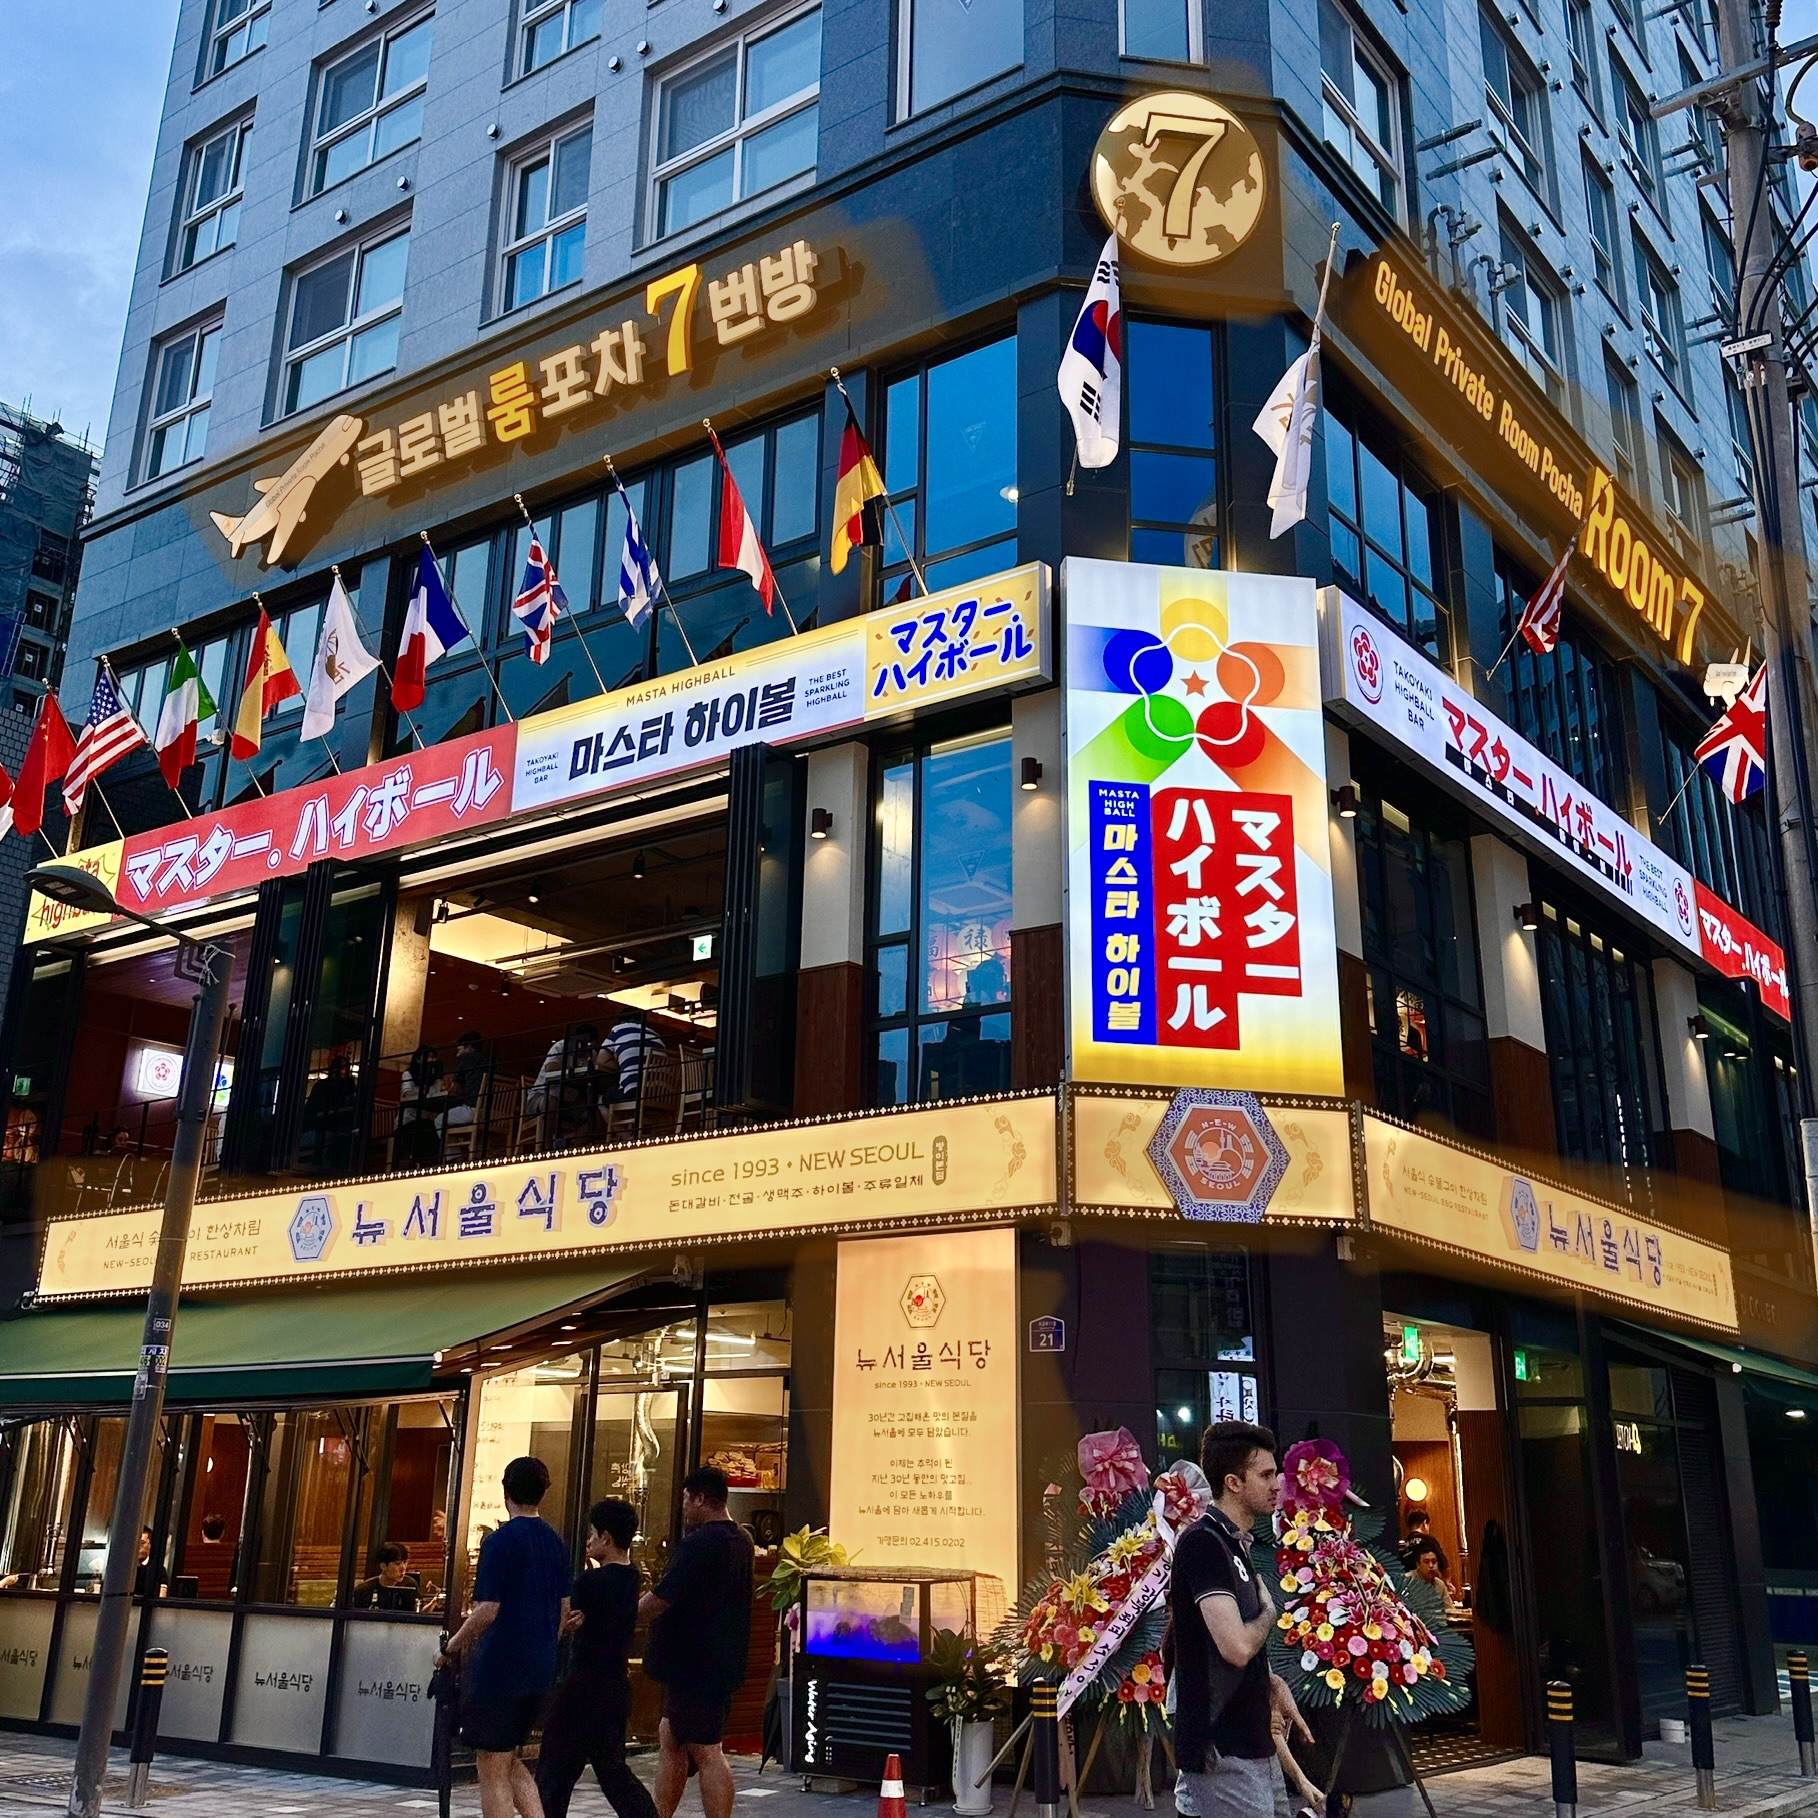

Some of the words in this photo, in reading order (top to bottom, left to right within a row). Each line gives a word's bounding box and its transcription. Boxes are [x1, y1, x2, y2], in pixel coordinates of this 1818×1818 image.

[1144, 111, 1230, 239] 7
[1374, 260, 1433, 352] Global
[1433, 326, 1495, 421] Private
[1498, 399, 1541, 474] Room
[1540, 446, 1583, 521] Pocha
[1678, 576, 1705, 667] 7
[873, 622, 1033, 697] ハイボール
[626, 686, 667, 707] MASTA
[672, 665, 736, 695] HIGHBALL
[808, 675, 824, 686] THE
[826, 668, 847, 682] BEST
[1393, 660, 1433, 701] TAKOYAKI
[804, 679, 850, 698] SPARKLING
[806, 691, 848, 708] HIGHBALL
[1394, 679, 1435, 721] HIGHBALL
[568, 711, 674, 781] 마스타
[684, 676, 797, 749] 하이볼
[1408, 708, 1425, 731] BAR
[525, 762, 559, 778] HIGHBALL
[526, 751, 560, 768] TAKOYAKI
[534, 774, 548, 785] BAR
[1098, 788, 1139, 800] MASTA
[1104, 800, 1135, 810] HIGH
[1104, 807, 1136, 818] BALL
[1103, 823, 1140, 919] 마스타
[1231, 809, 1300, 980] マスター
[1165, 798, 1227, 1031] ハイボール
[1105, 932, 1142, 1031] 하이볼
[670, 1167, 725, 1187] since
[732, 1157, 780, 1180] 1993
[799, 1149, 846, 1173] NEW
[850, 1141, 925, 1167] SEOUL
[1199, 1177, 1241, 1191] SEOUL
[351, 1163, 628, 1247] 뉴서울식당
[105, 1231, 145, 1251] 서울식
[206, 1218, 262, 1241] 한상차림
[1547, 1202, 1663, 1288] 뉴서울식당
[190, 1245, 259, 1262] RESTAURANT
[155, 1321, 169, 1329] 034
[1039, 1333, 1054, 1347] 21
[856, 1339, 992, 1371] 뉴서울식당
[874, 1380, 896, 1389] since
[898, 1380, 918, 1389] 1993
[924, 1379, 943, 1387] NEW
[943, 1378, 972, 1387] SEOUL
[868, 1412, 895, 1422] 30년간
[907, 1427, 924, 1438] 모두
[871, 1474, 888, 1484] 지난
[890, 1474, 910, 1484] 30년
[889, 1490, 898, 1499] 이
[909, 1537, 966, 1548] 02.415.0202
[1233, 1555, 1250, 1583] 8
[254, 1671, 313, 1693] 뉴서울식당
[357, 1680, 421, 1702] 뉴서울식당
